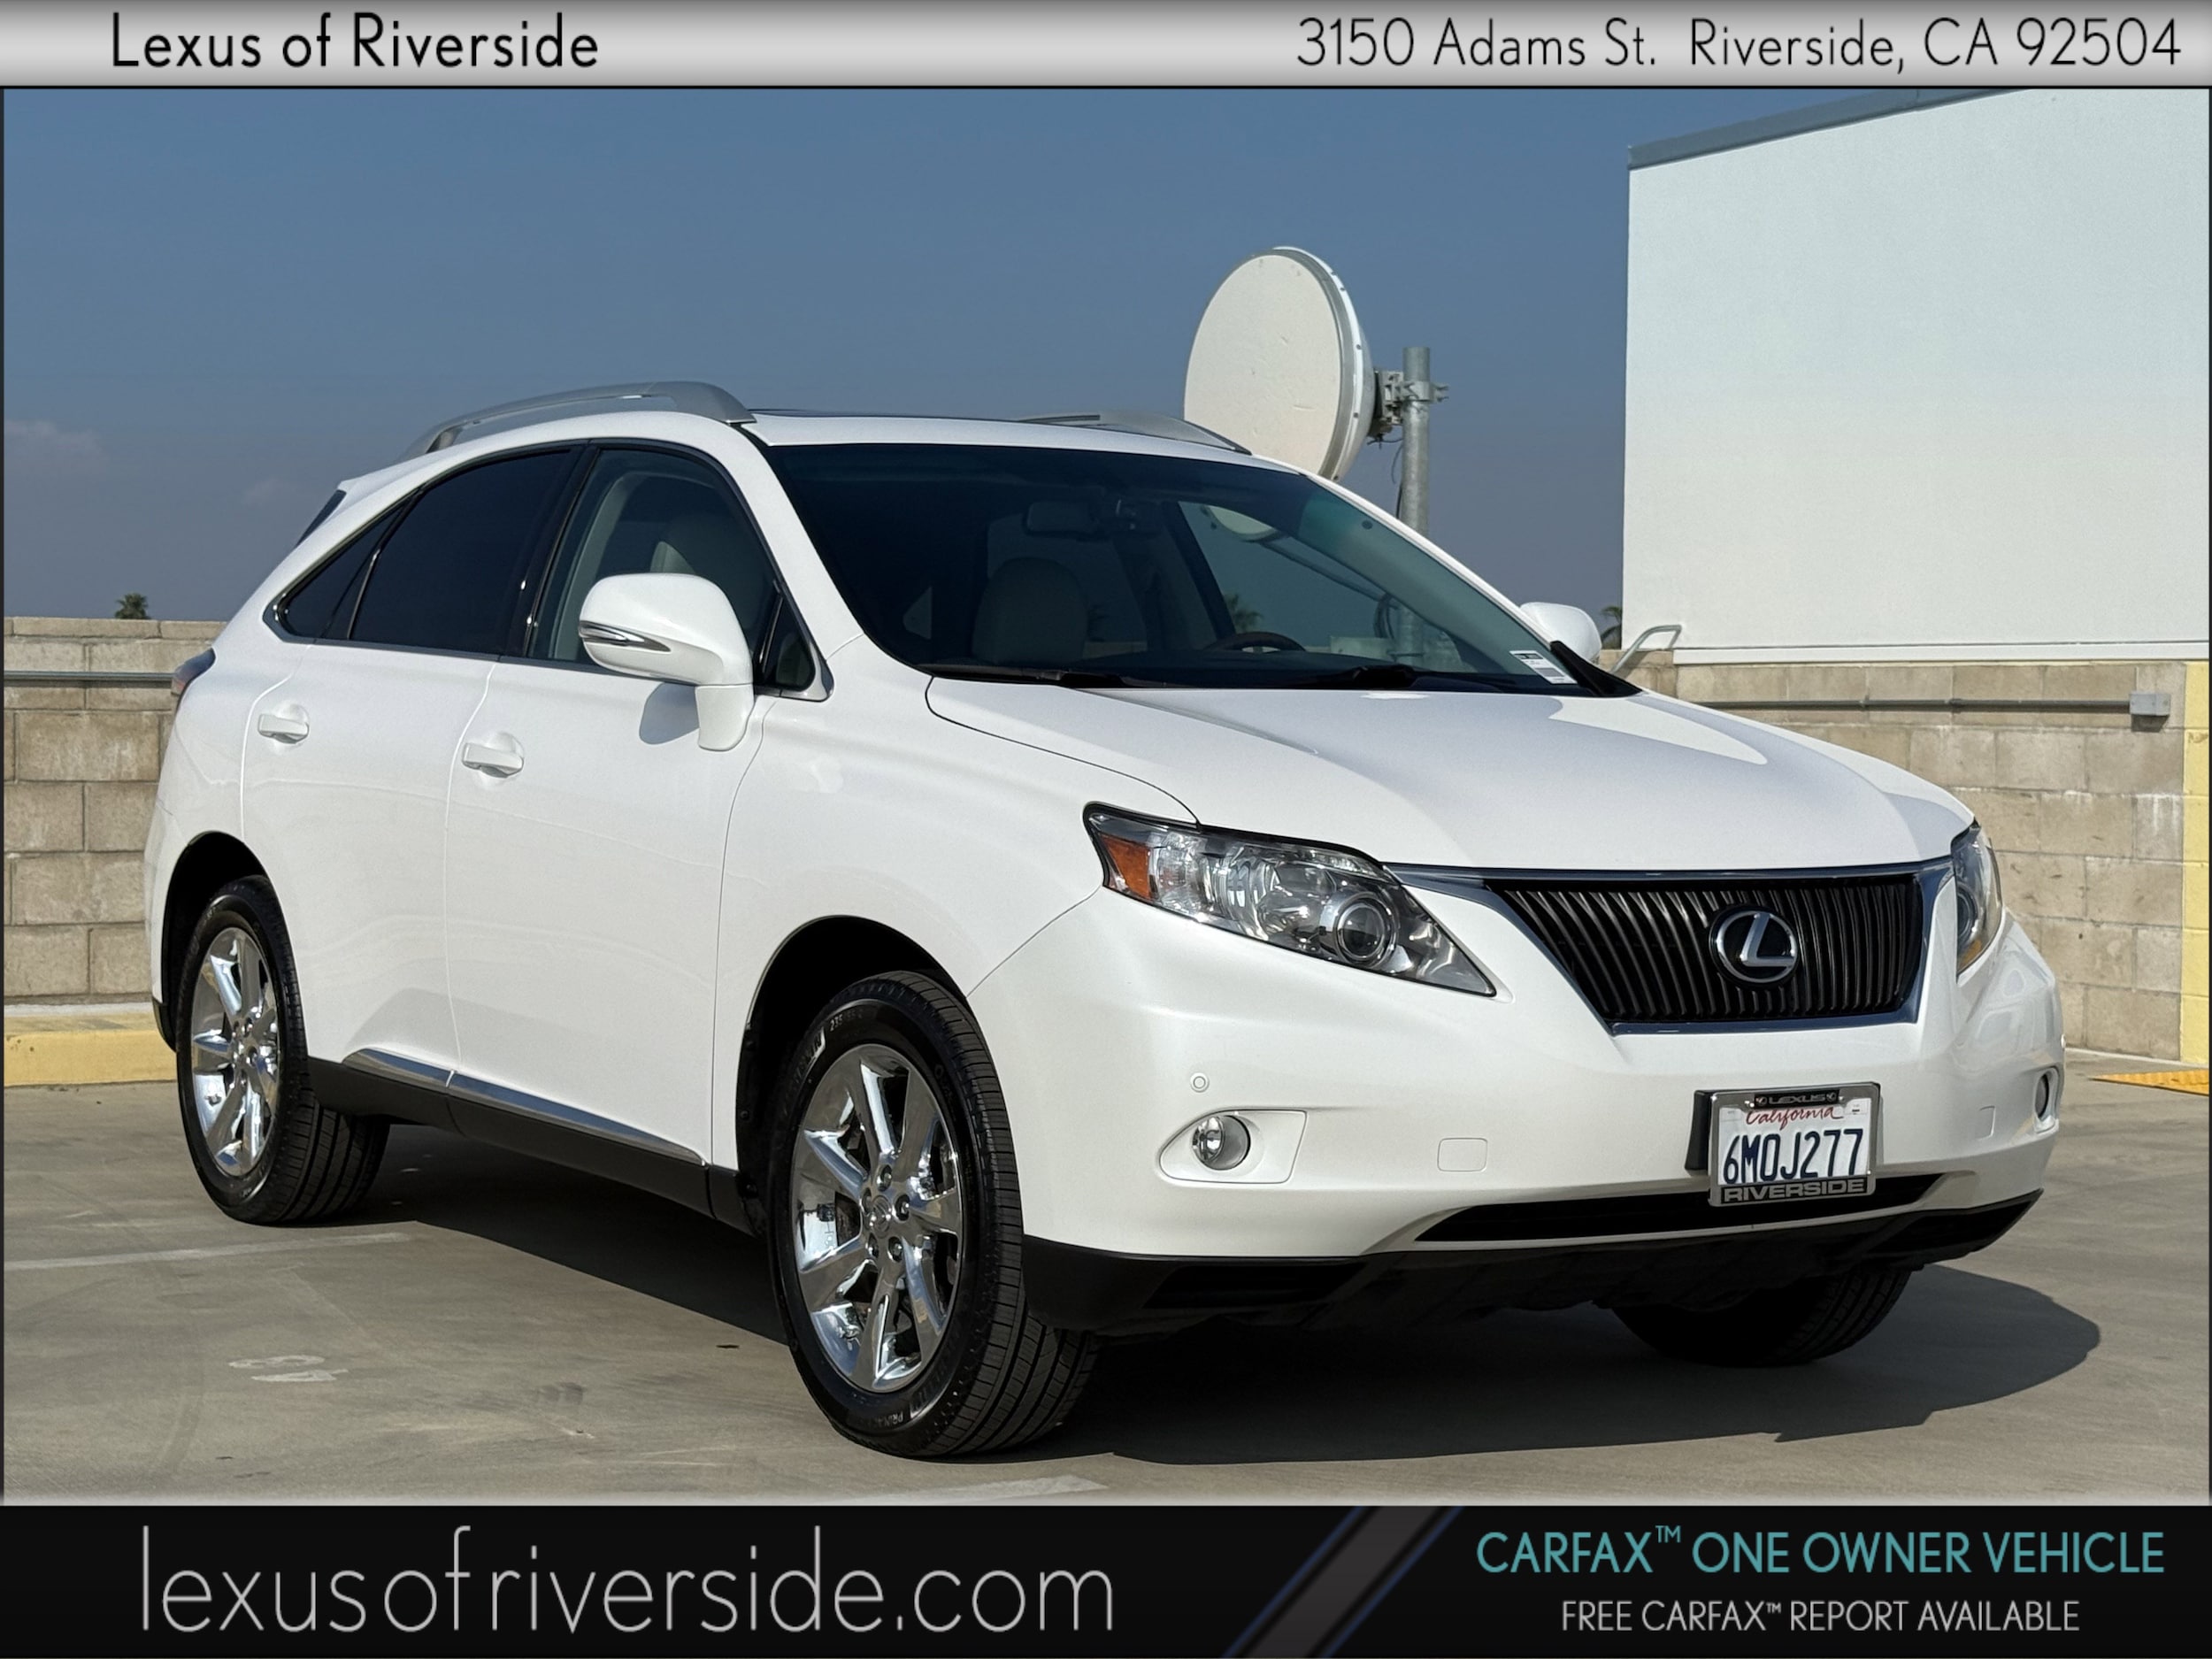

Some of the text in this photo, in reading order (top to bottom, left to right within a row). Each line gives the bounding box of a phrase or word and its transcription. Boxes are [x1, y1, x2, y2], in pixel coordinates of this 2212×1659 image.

[1770, 1092, 1826, 1105] LEXUS
[1746, 1106, 1844, 1131] California
[1723, 1128, 1863, 1185] 6MOJ277
[1725, 1179, 1865, 1203] RIVERSIDE
